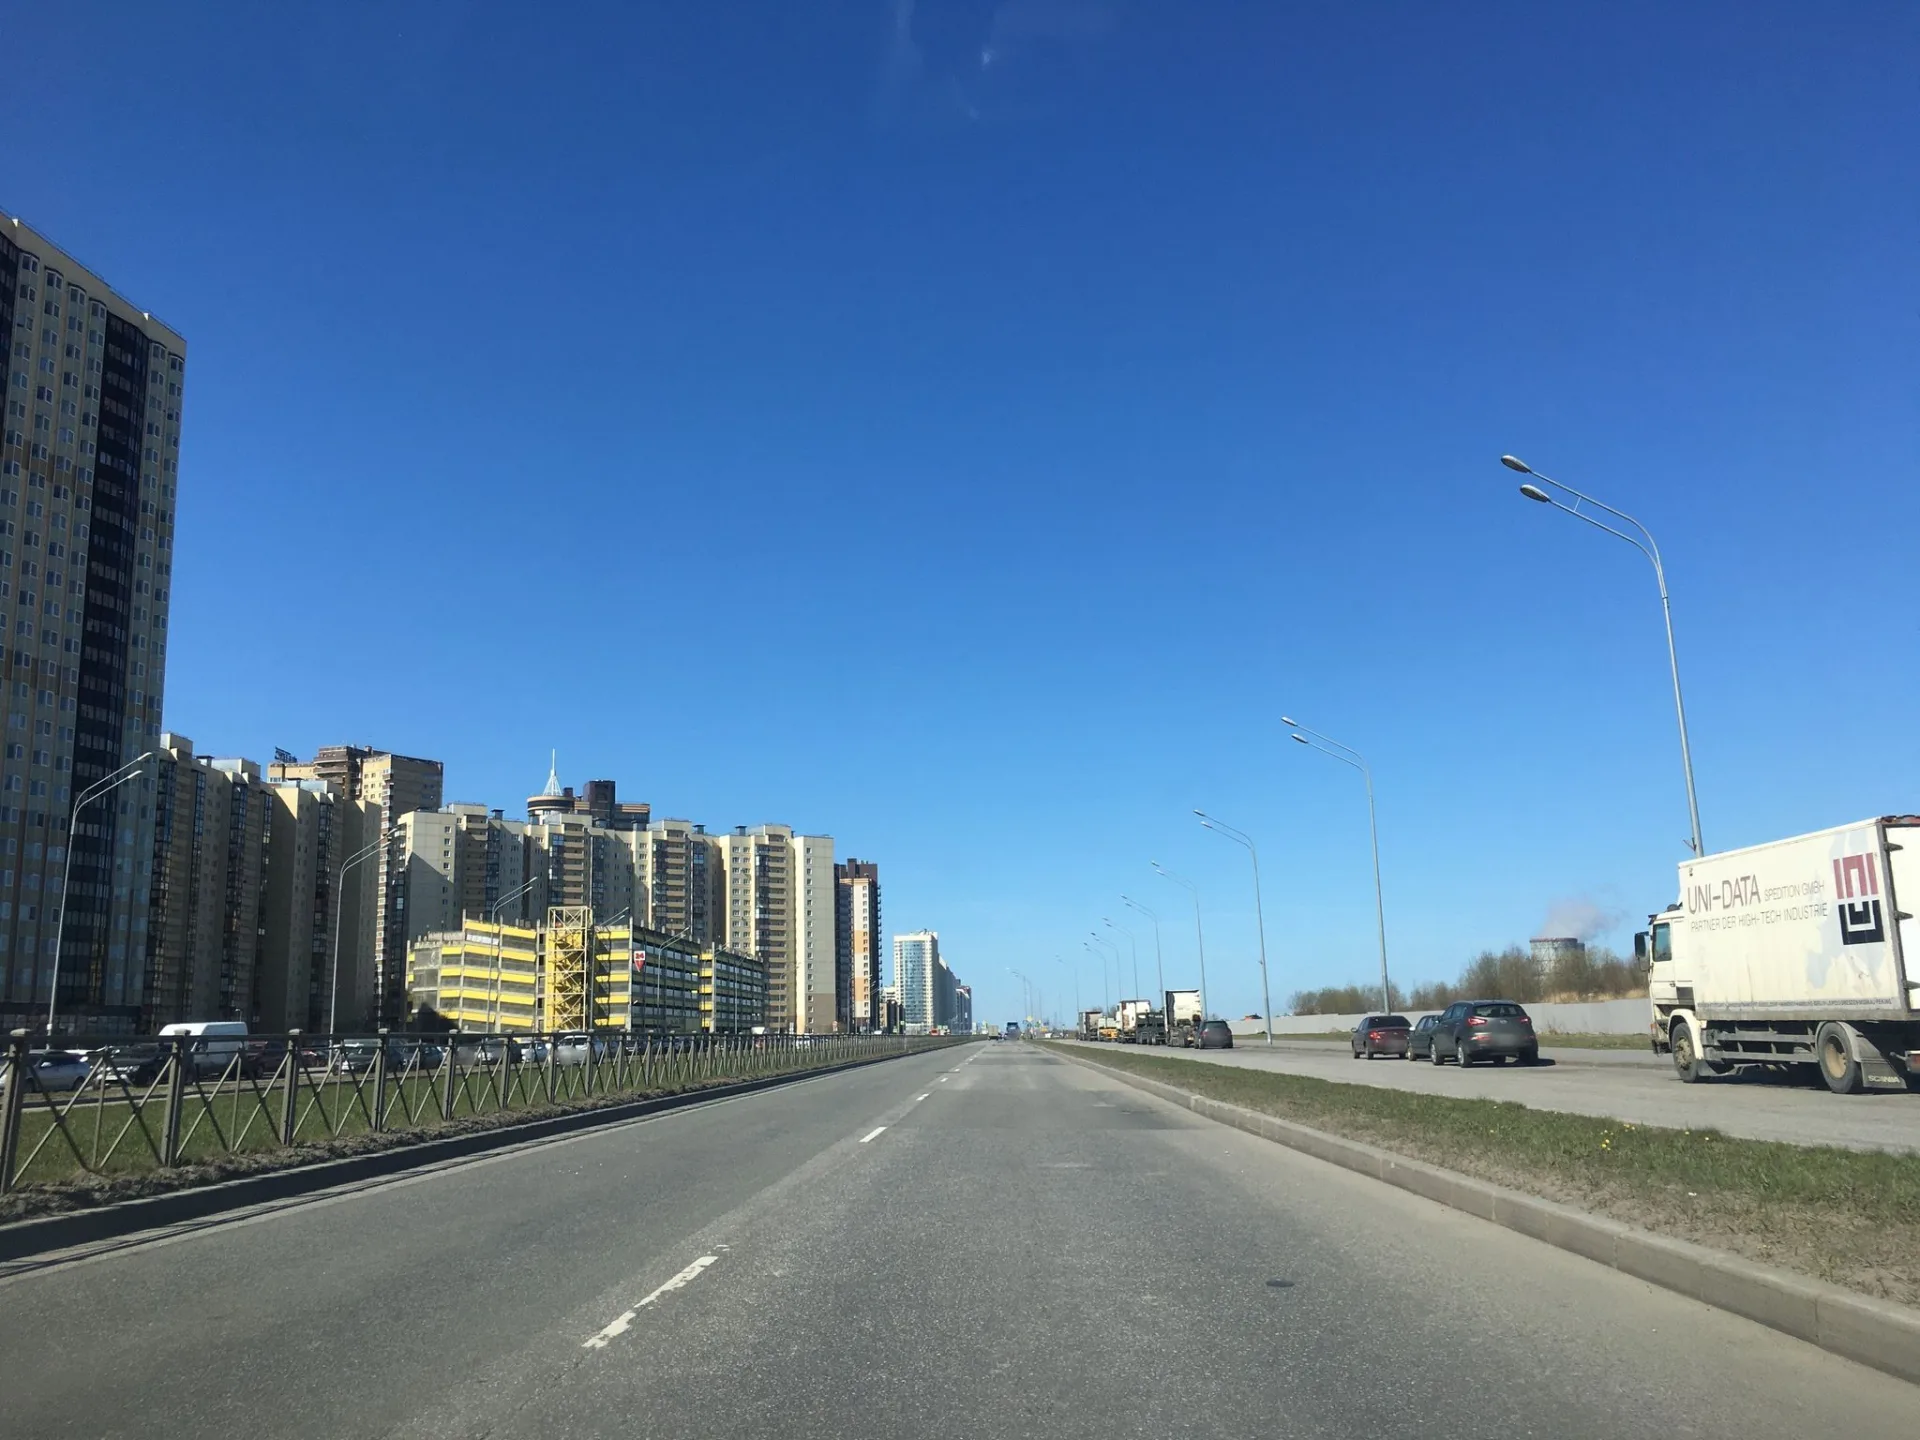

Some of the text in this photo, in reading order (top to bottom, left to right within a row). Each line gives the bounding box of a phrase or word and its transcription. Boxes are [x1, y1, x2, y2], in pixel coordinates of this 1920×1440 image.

[1687, 874, 1761, 915] UNI-DATA
[1691, 918, 1721, 932] PARTNER
[1722, 915, 1736, 930] DER
[1783, 902, 1828, 921] INDUSTRIE
